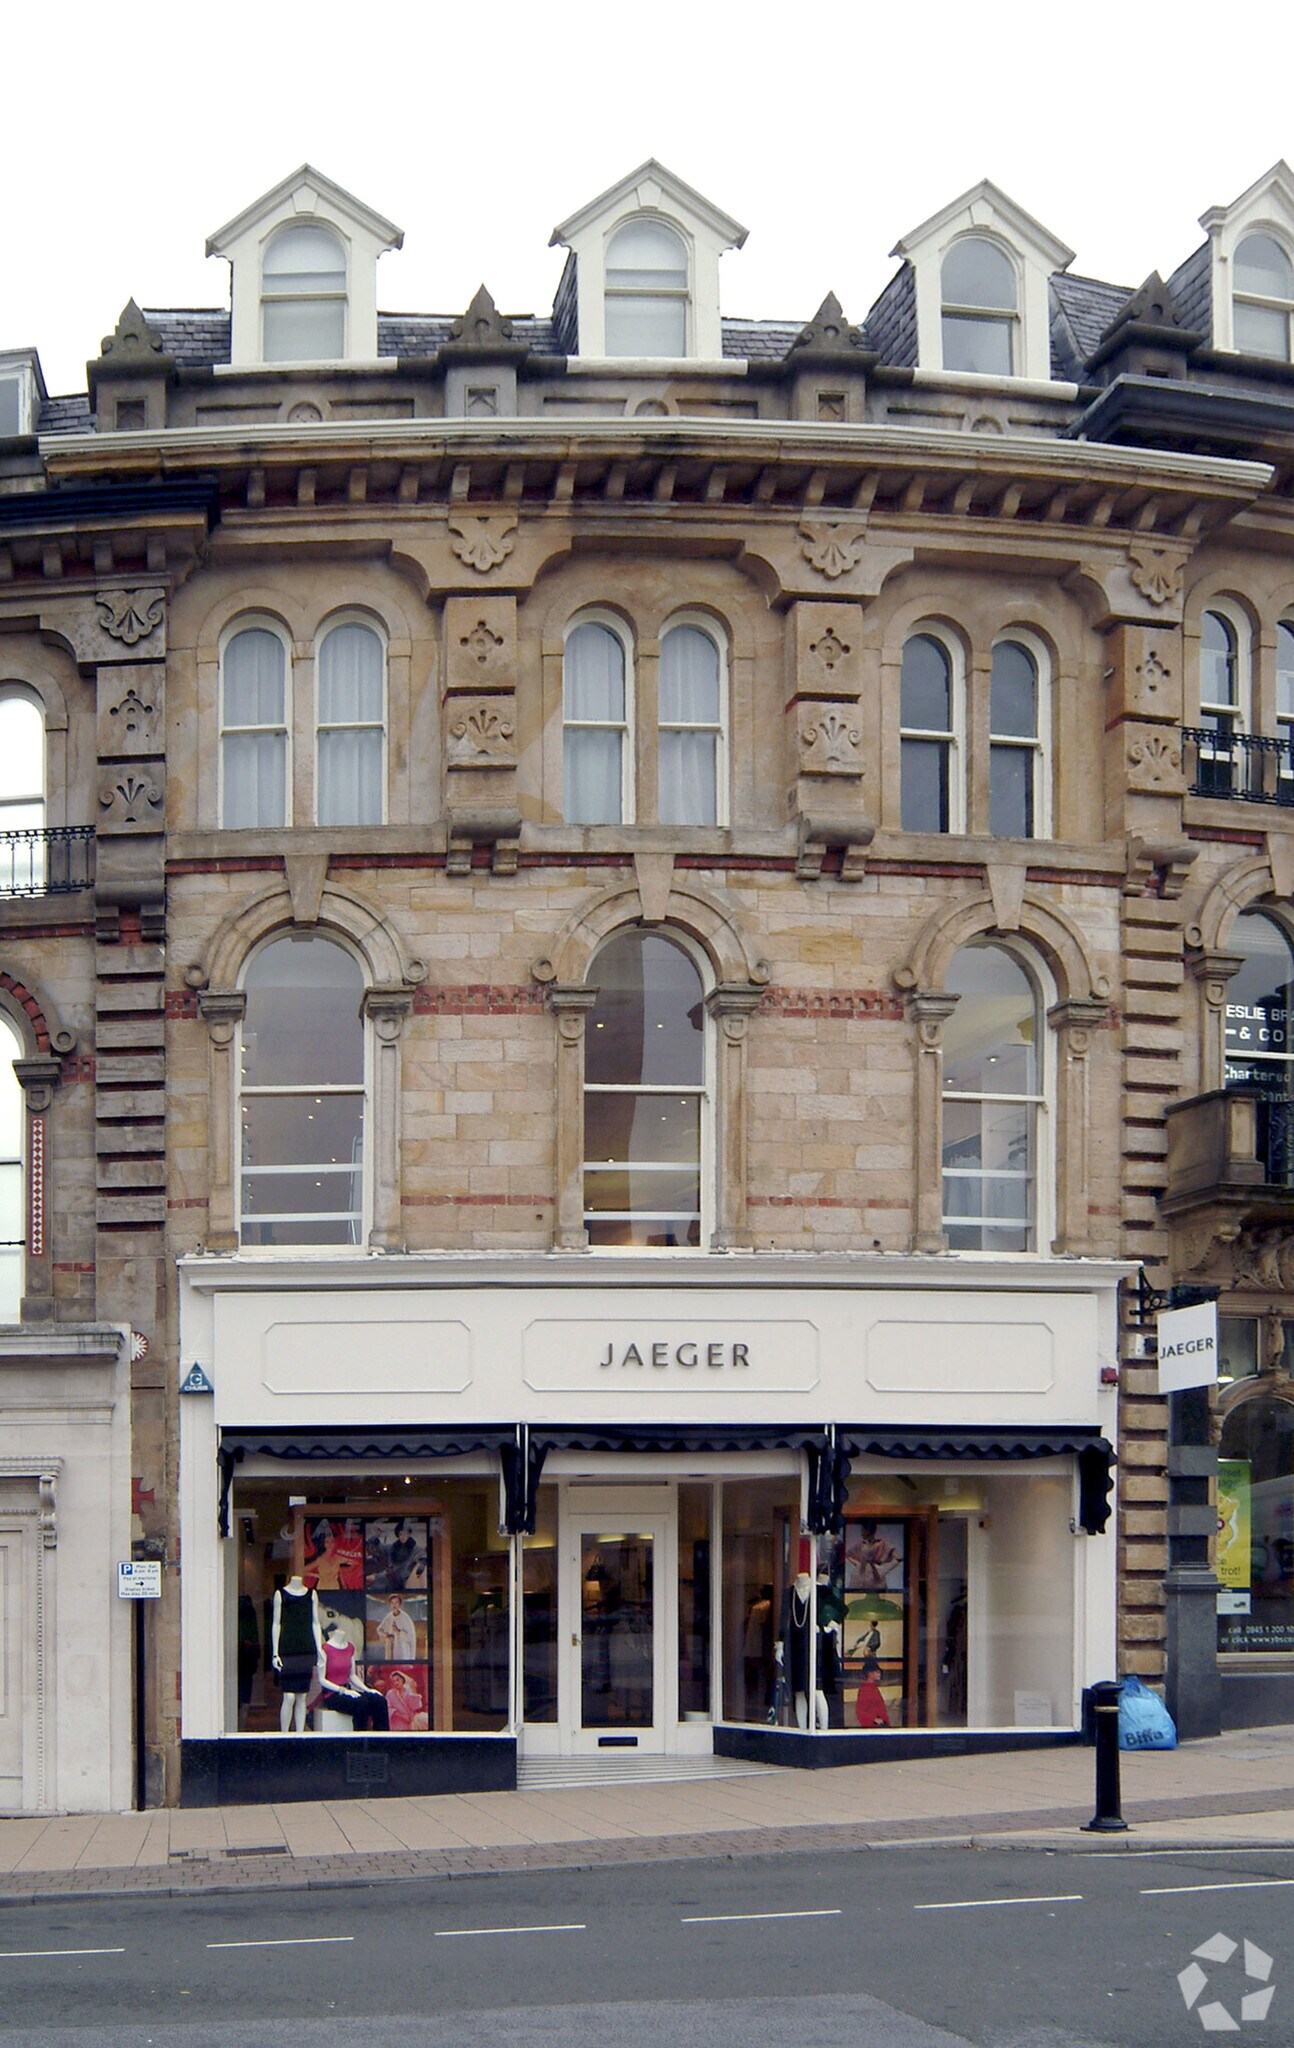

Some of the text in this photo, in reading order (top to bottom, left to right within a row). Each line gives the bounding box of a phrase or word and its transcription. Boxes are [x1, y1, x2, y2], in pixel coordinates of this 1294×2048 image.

[1225, 1004, 1266, 1020] ESLIE
[1239, 1026, 1251, 1040] &
[600, 1342, 750, 1367] JAEGER
[1159, 1337, 1215, 1359] JAEGER
